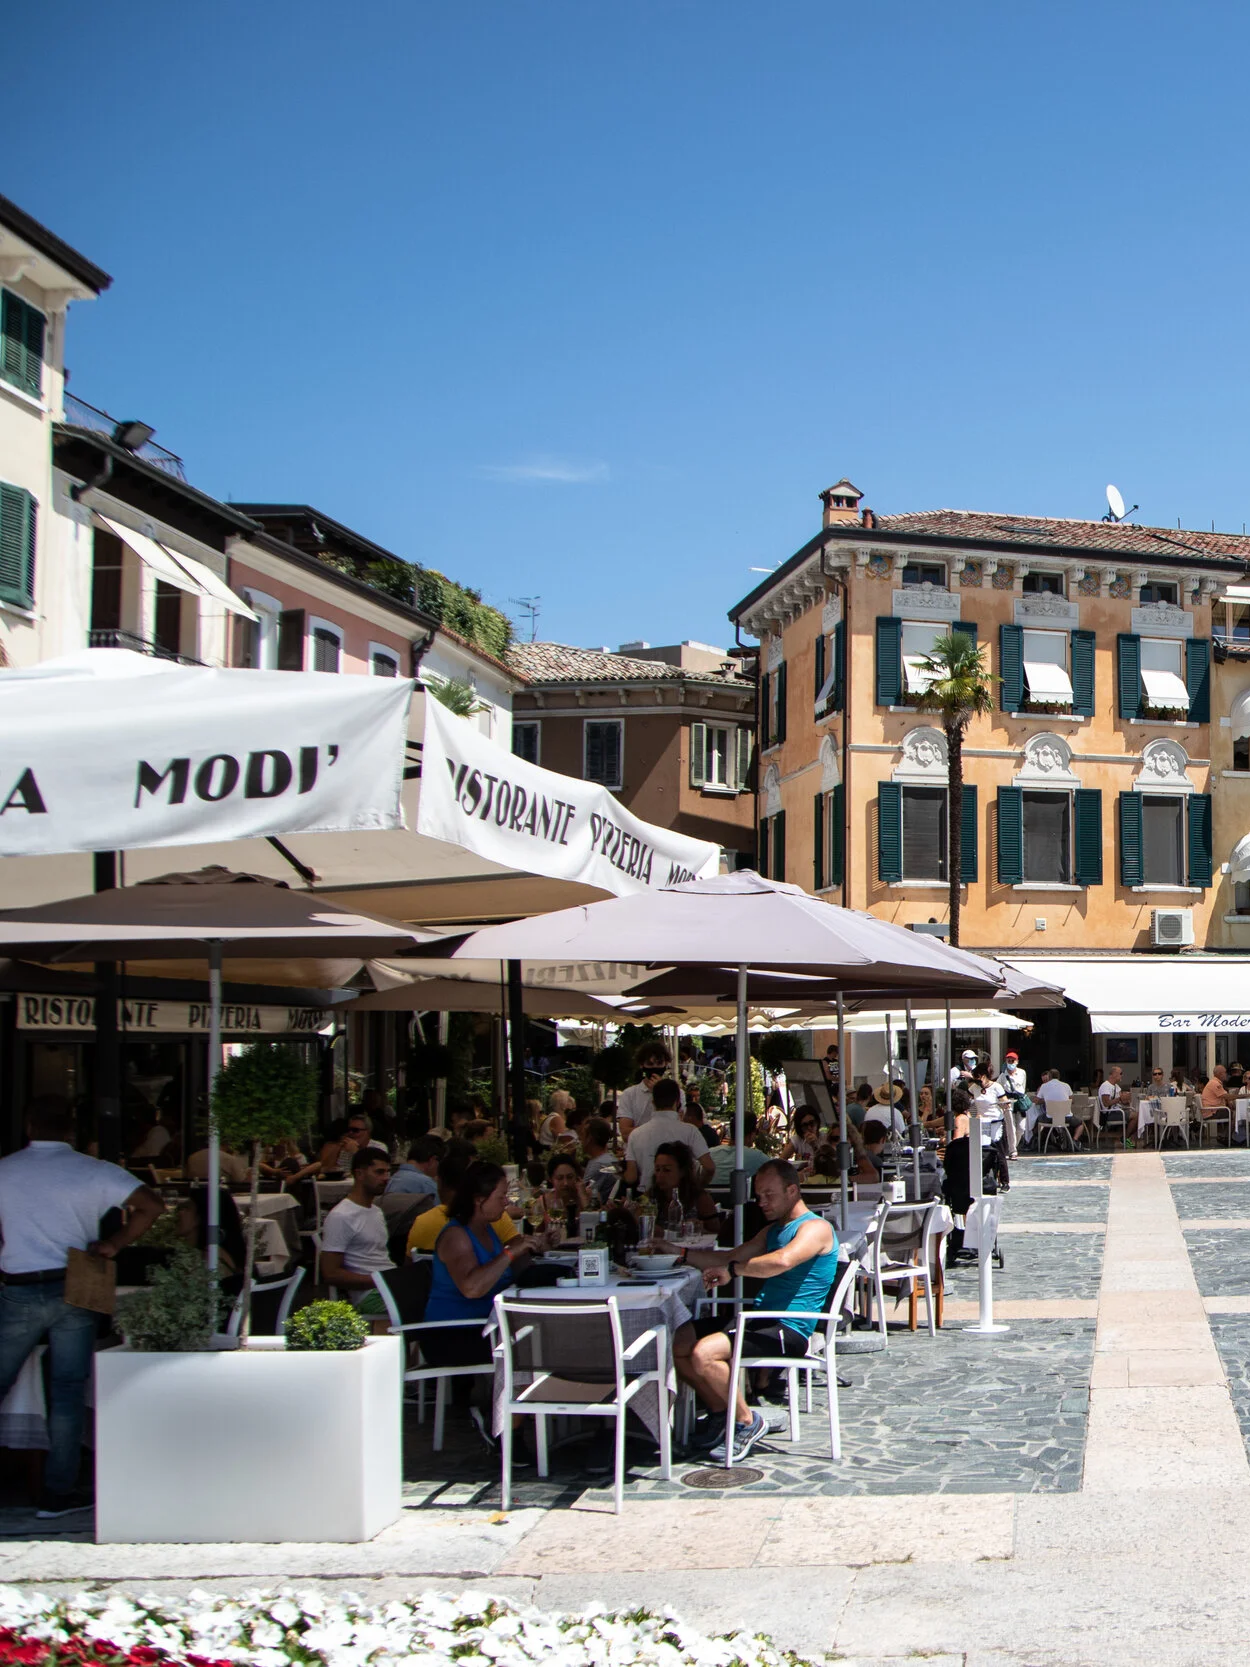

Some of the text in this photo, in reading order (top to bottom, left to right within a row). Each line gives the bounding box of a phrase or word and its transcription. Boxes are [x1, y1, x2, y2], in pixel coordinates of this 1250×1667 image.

[0, 744, 339, 816] A MODI'
[25, 996, 158, 1027] RISTONTE
[1158, 1013, 1191, 1028] Bar
